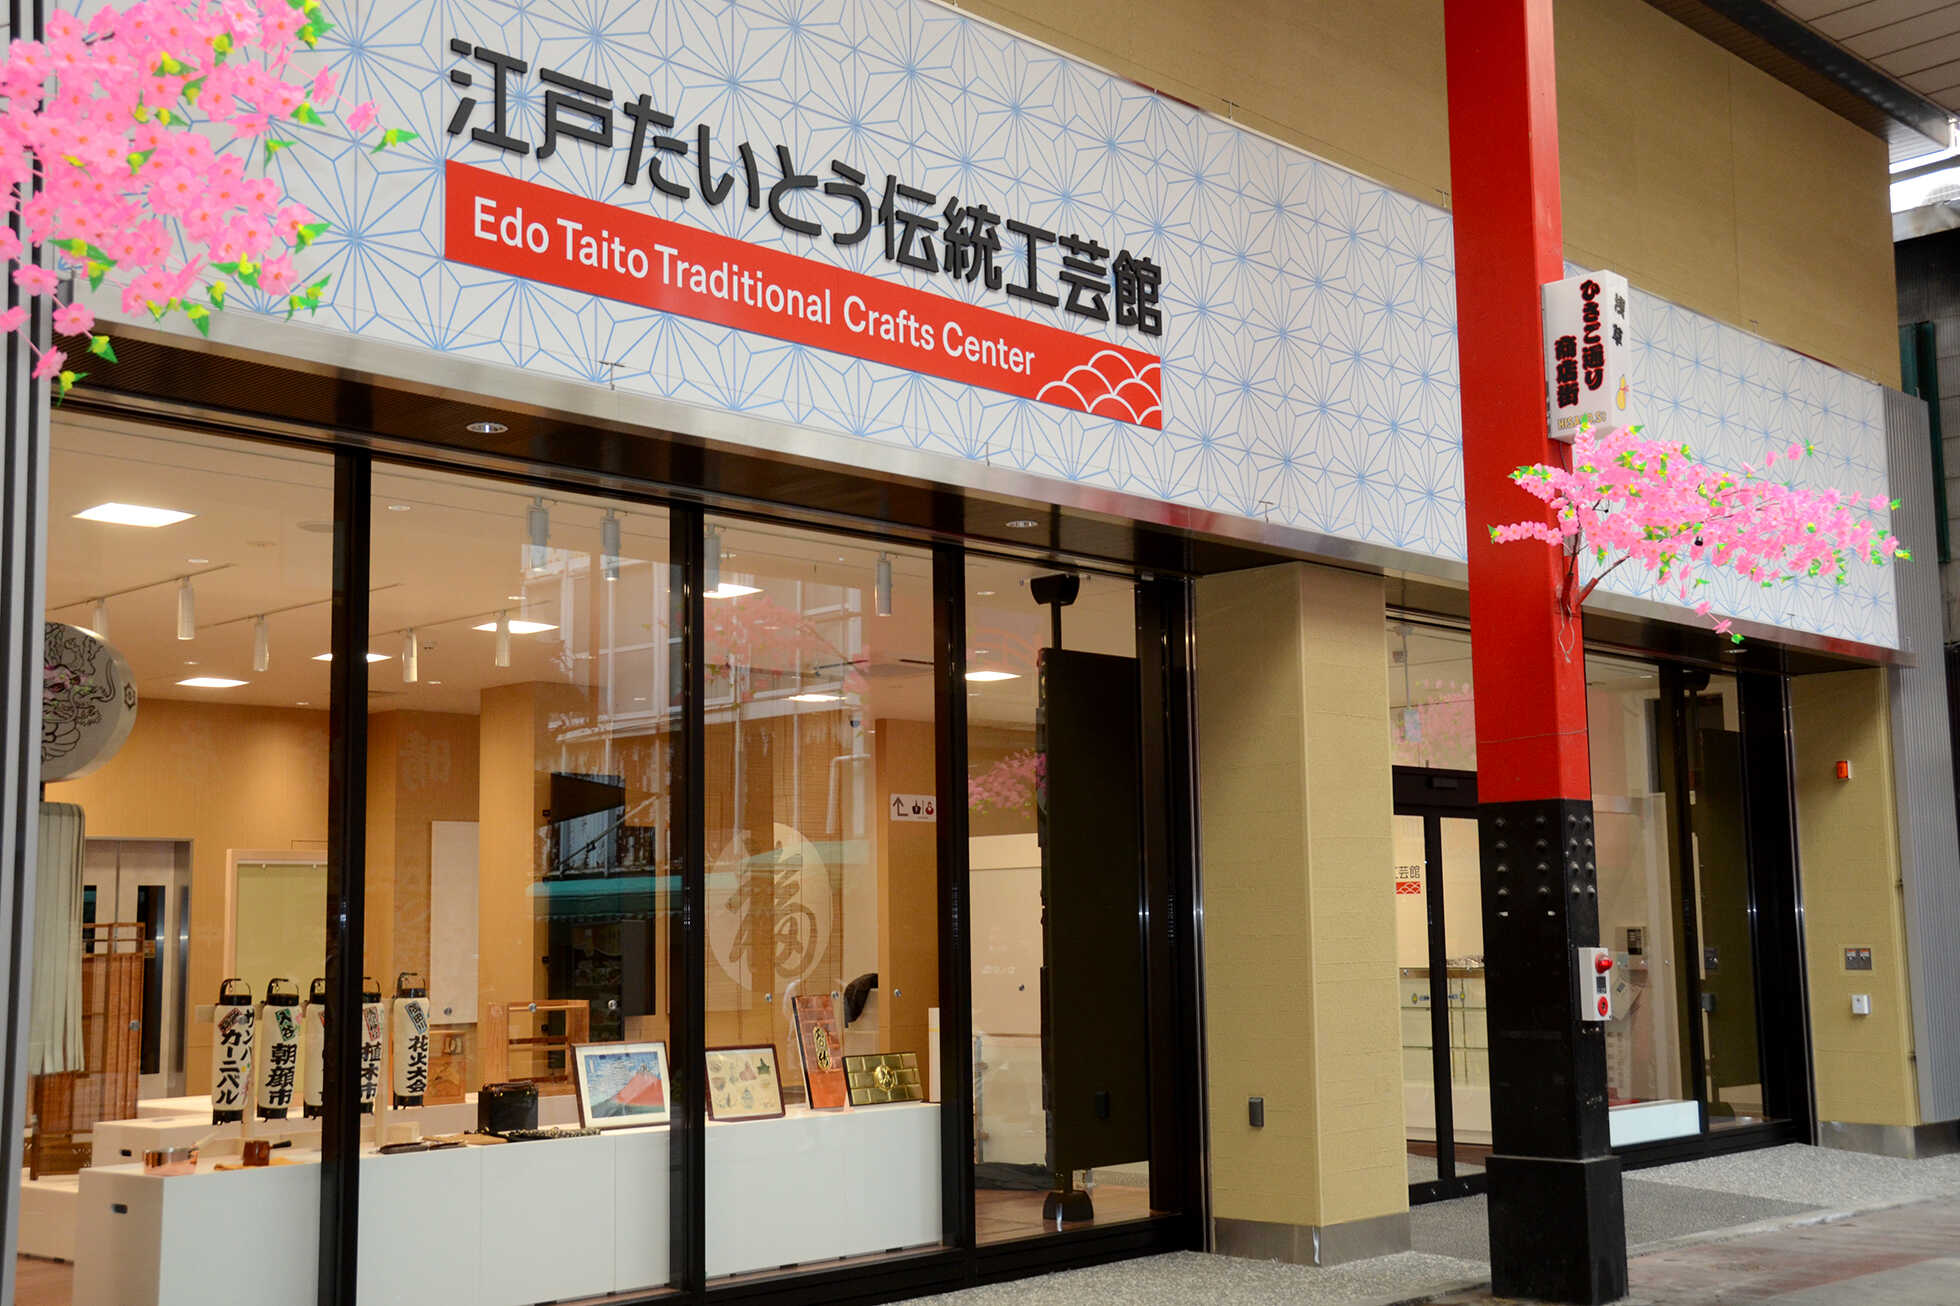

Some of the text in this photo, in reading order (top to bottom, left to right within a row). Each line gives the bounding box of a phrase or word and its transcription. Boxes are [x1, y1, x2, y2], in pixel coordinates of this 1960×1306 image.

[447, 38, 1163, 338] 江戸たいとう伝統工芸館
[474, 196, 1037, 376] Edo Taito Traditional Crafts Center
[1554, 335, 1580, 409] 商店街
[1580, 279, 1605, 391] ひさご通り
[216, 1029, 242, 1105] カーニバル
[265, 1043, 298, 1106] 朝顔市
[361, 1041, 382, 1099] 植木市
[406, 1034, 429, 1093] 花火大会
